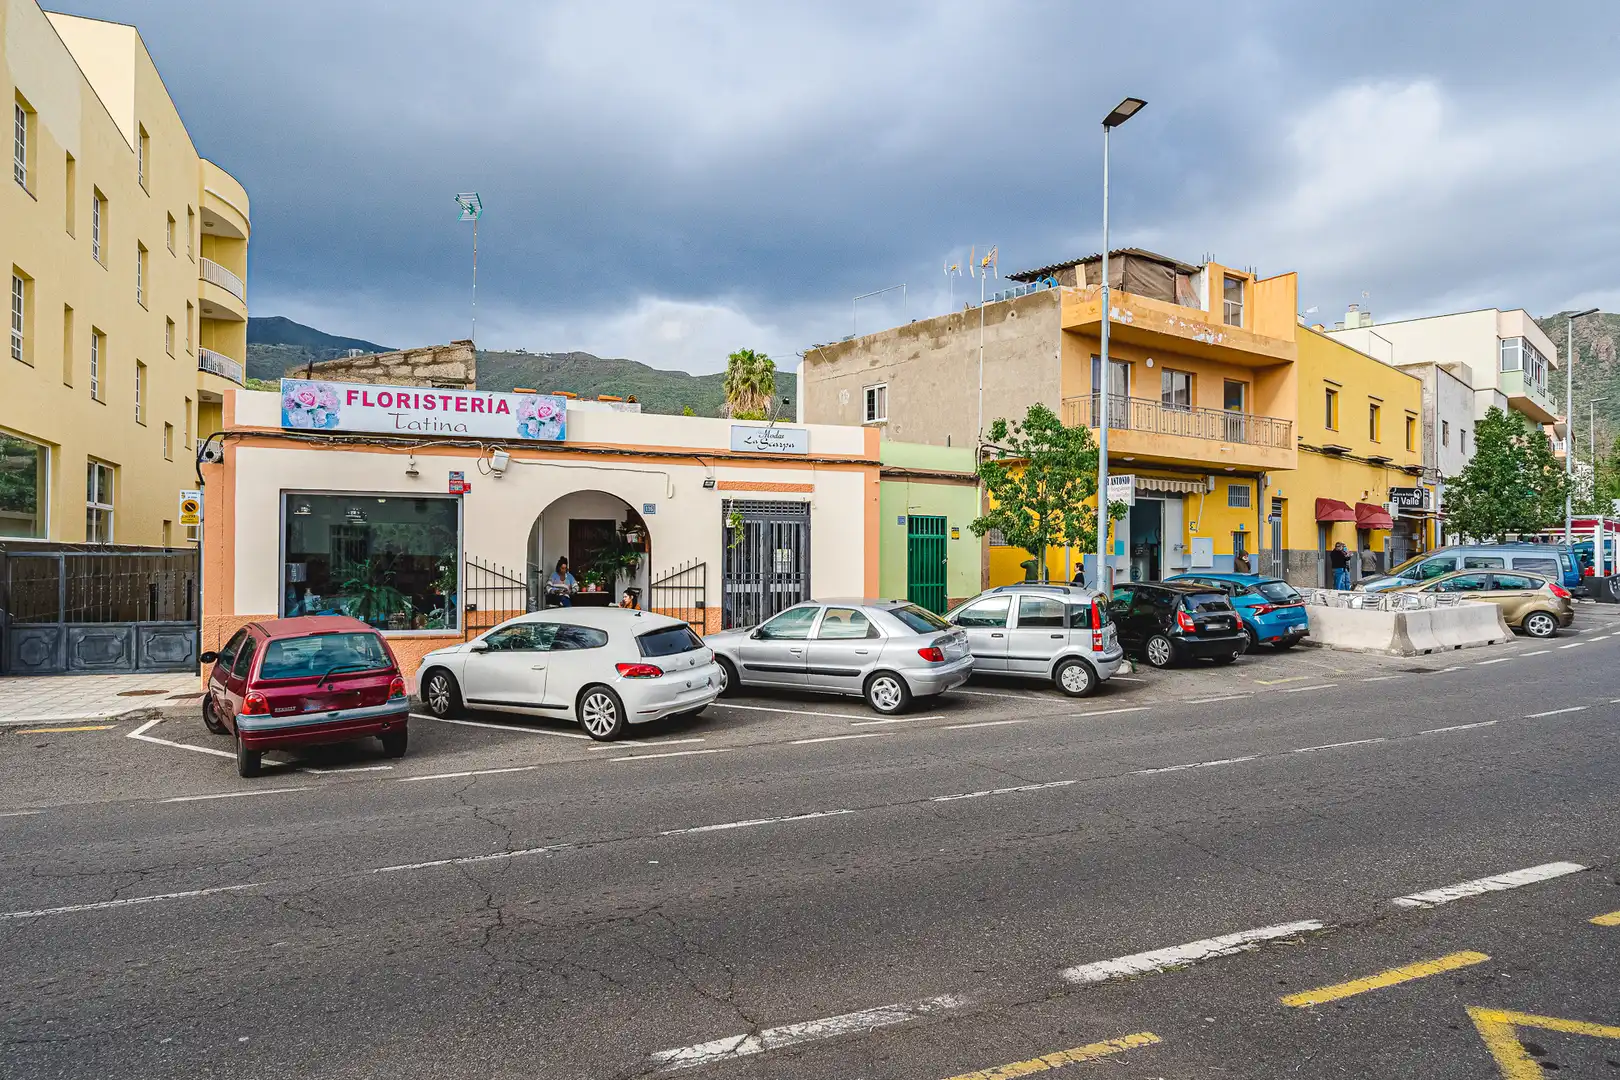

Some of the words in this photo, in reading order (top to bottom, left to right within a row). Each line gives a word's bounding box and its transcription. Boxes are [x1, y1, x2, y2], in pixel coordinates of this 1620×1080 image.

[346, 390, 511, 414] FLORISTERÍA
[388, 412, 468, 433] Tatina
[1110, 476, 1130, 485] ANTONIO
[1401, 497, 1419, 505] Valle
